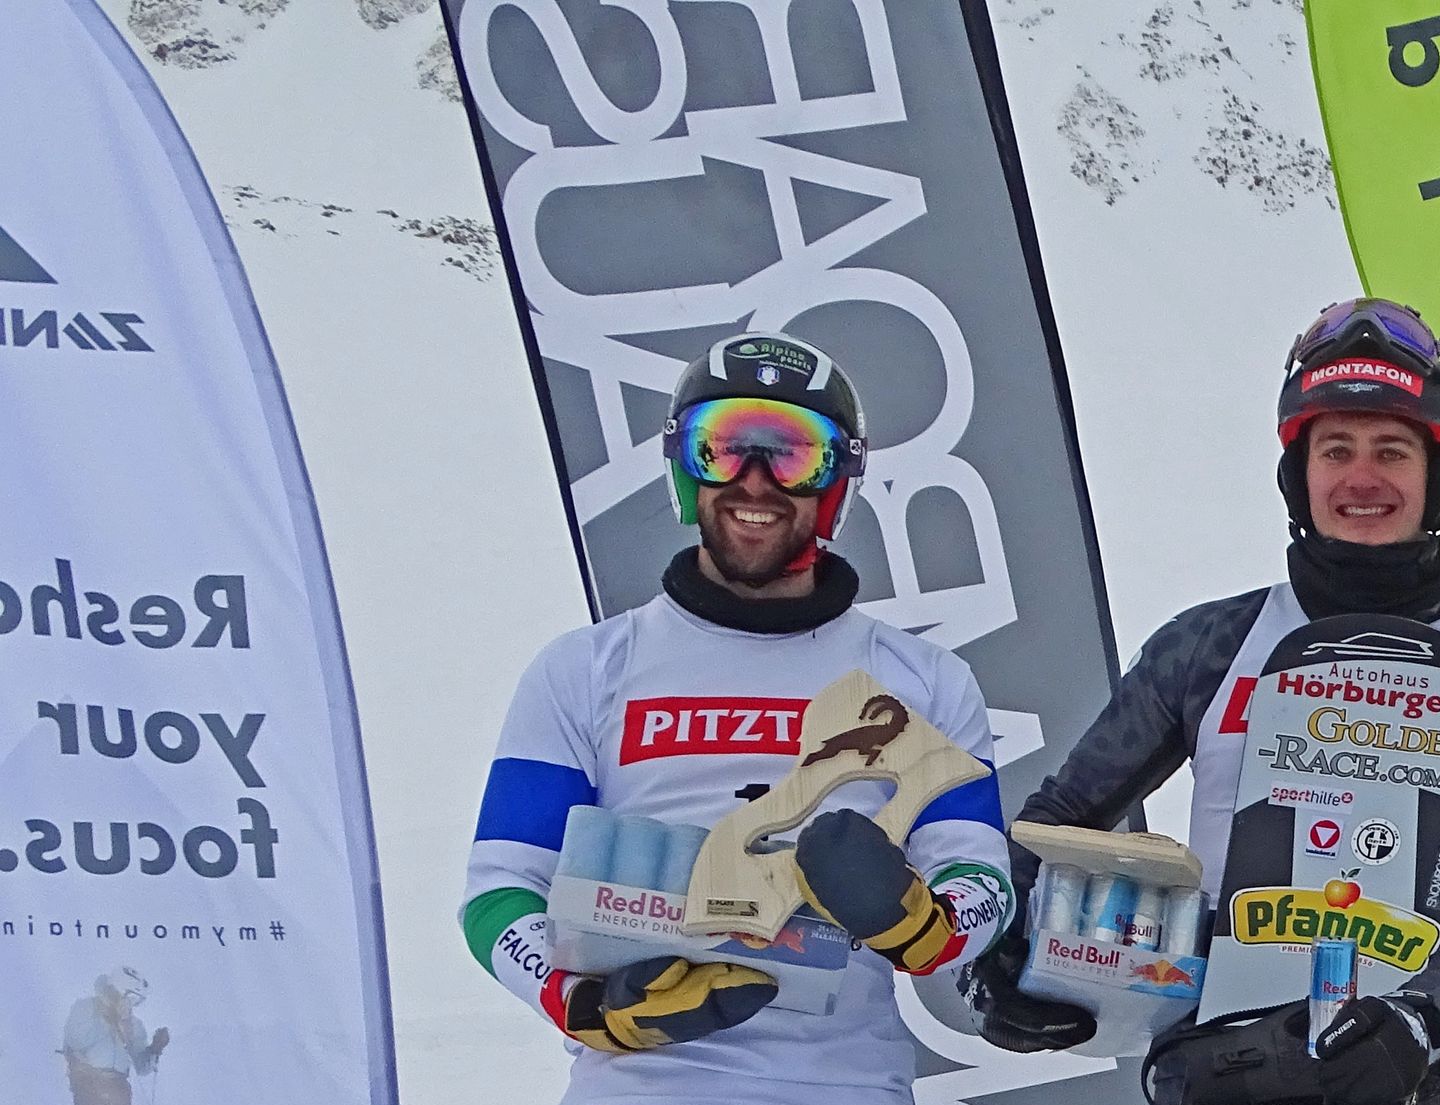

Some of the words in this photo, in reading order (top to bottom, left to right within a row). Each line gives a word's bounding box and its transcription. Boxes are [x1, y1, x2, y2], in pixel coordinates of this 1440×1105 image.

[1311, 363, 1413, 387] MONTAFON
[1329, 663, 1430, 689] Autohaus
[640, 707, 803, 747] PITZT
[1271, 787, 1341, 806] sporthilfe
[598, 886, 646, 916] Red
[593, 911, 647, 930] ENERGY
[1047, 938, 1085, 961] Red
[1086, 946, 1121, 968] Bull
[1324, 981, 1348, 994] Red
